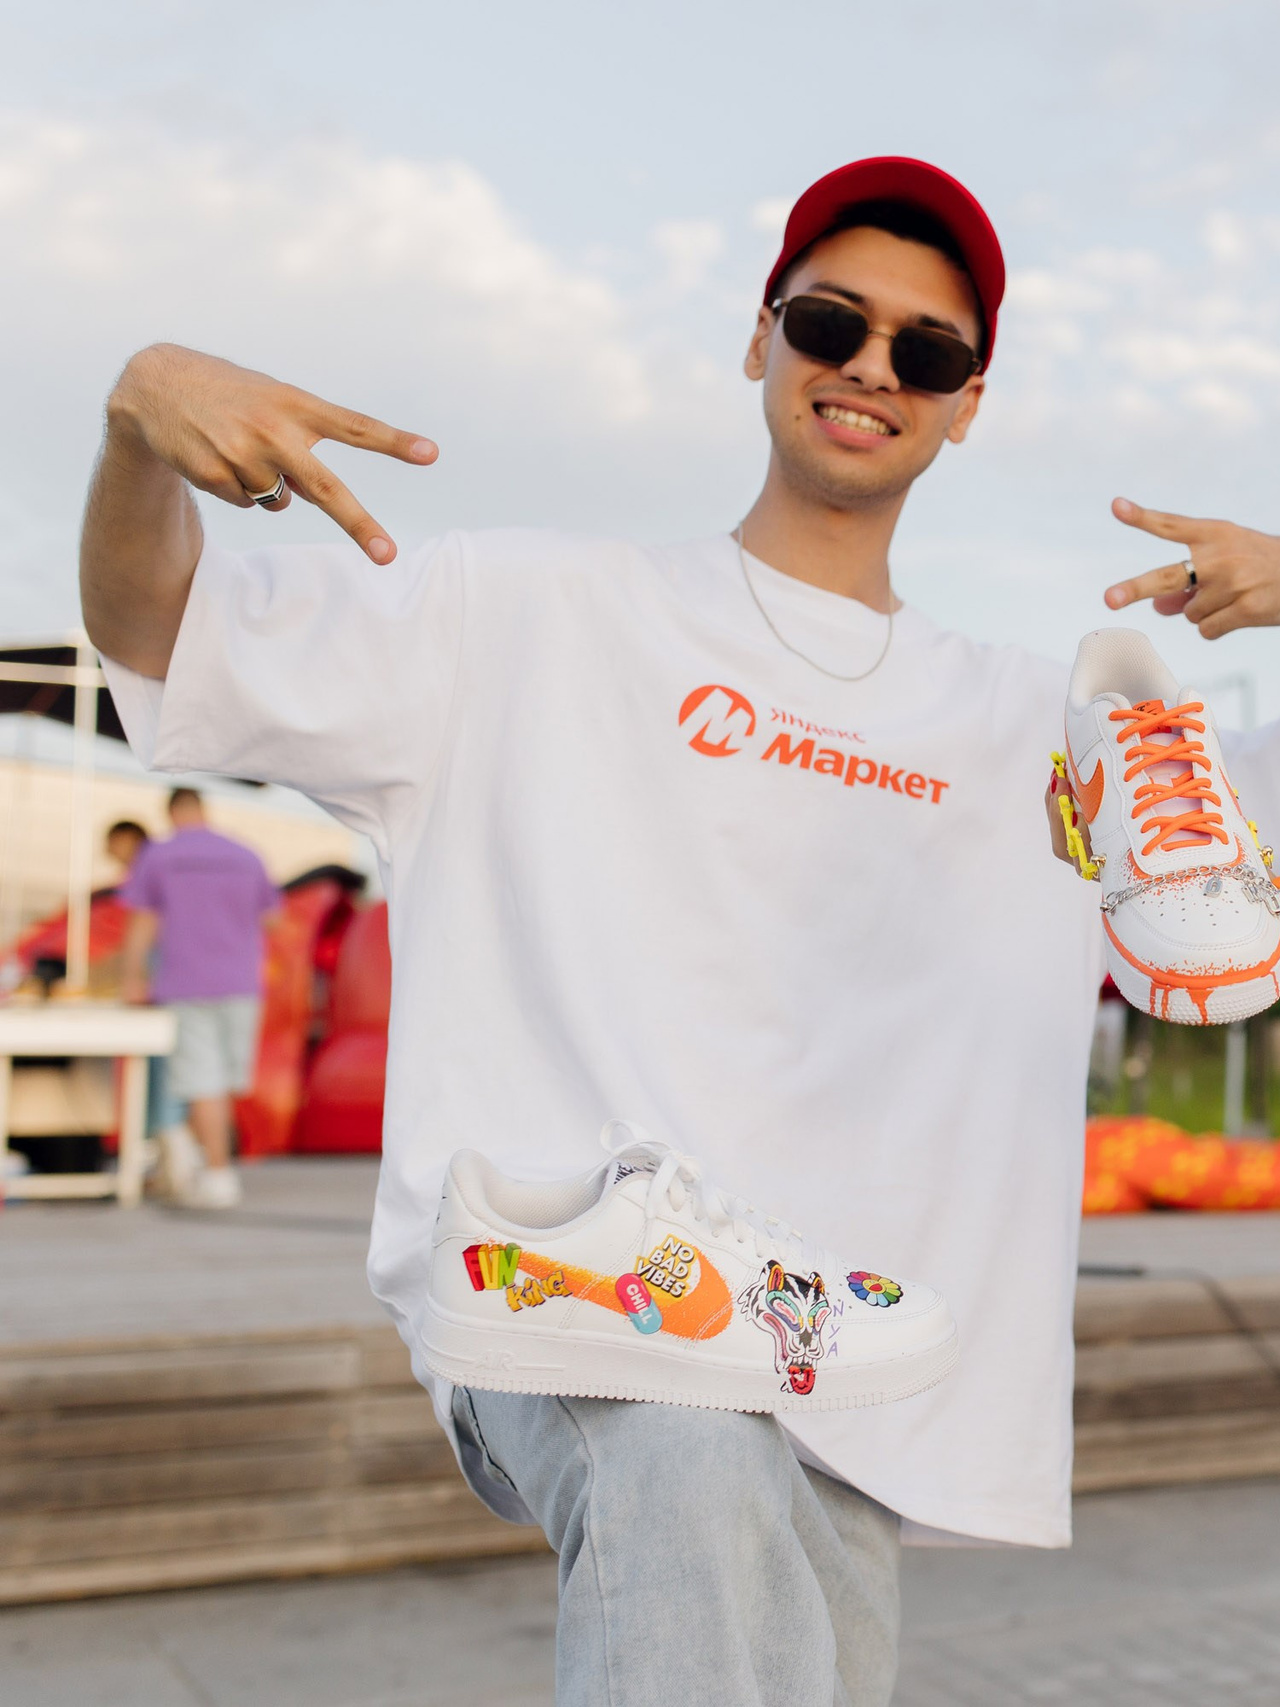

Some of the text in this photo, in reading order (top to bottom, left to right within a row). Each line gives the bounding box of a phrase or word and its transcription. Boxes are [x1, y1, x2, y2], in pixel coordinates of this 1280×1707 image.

[760, 732, 950, 805] Маркет
[462, 1242, 522, 1292] FUN
[649, 1248, 690, 1280] BAD
[662, 1236, 695, 1264] NO
[636, 1259, 687, 1299] VIBES
[626, 1283, 653, 1325] CHILL
